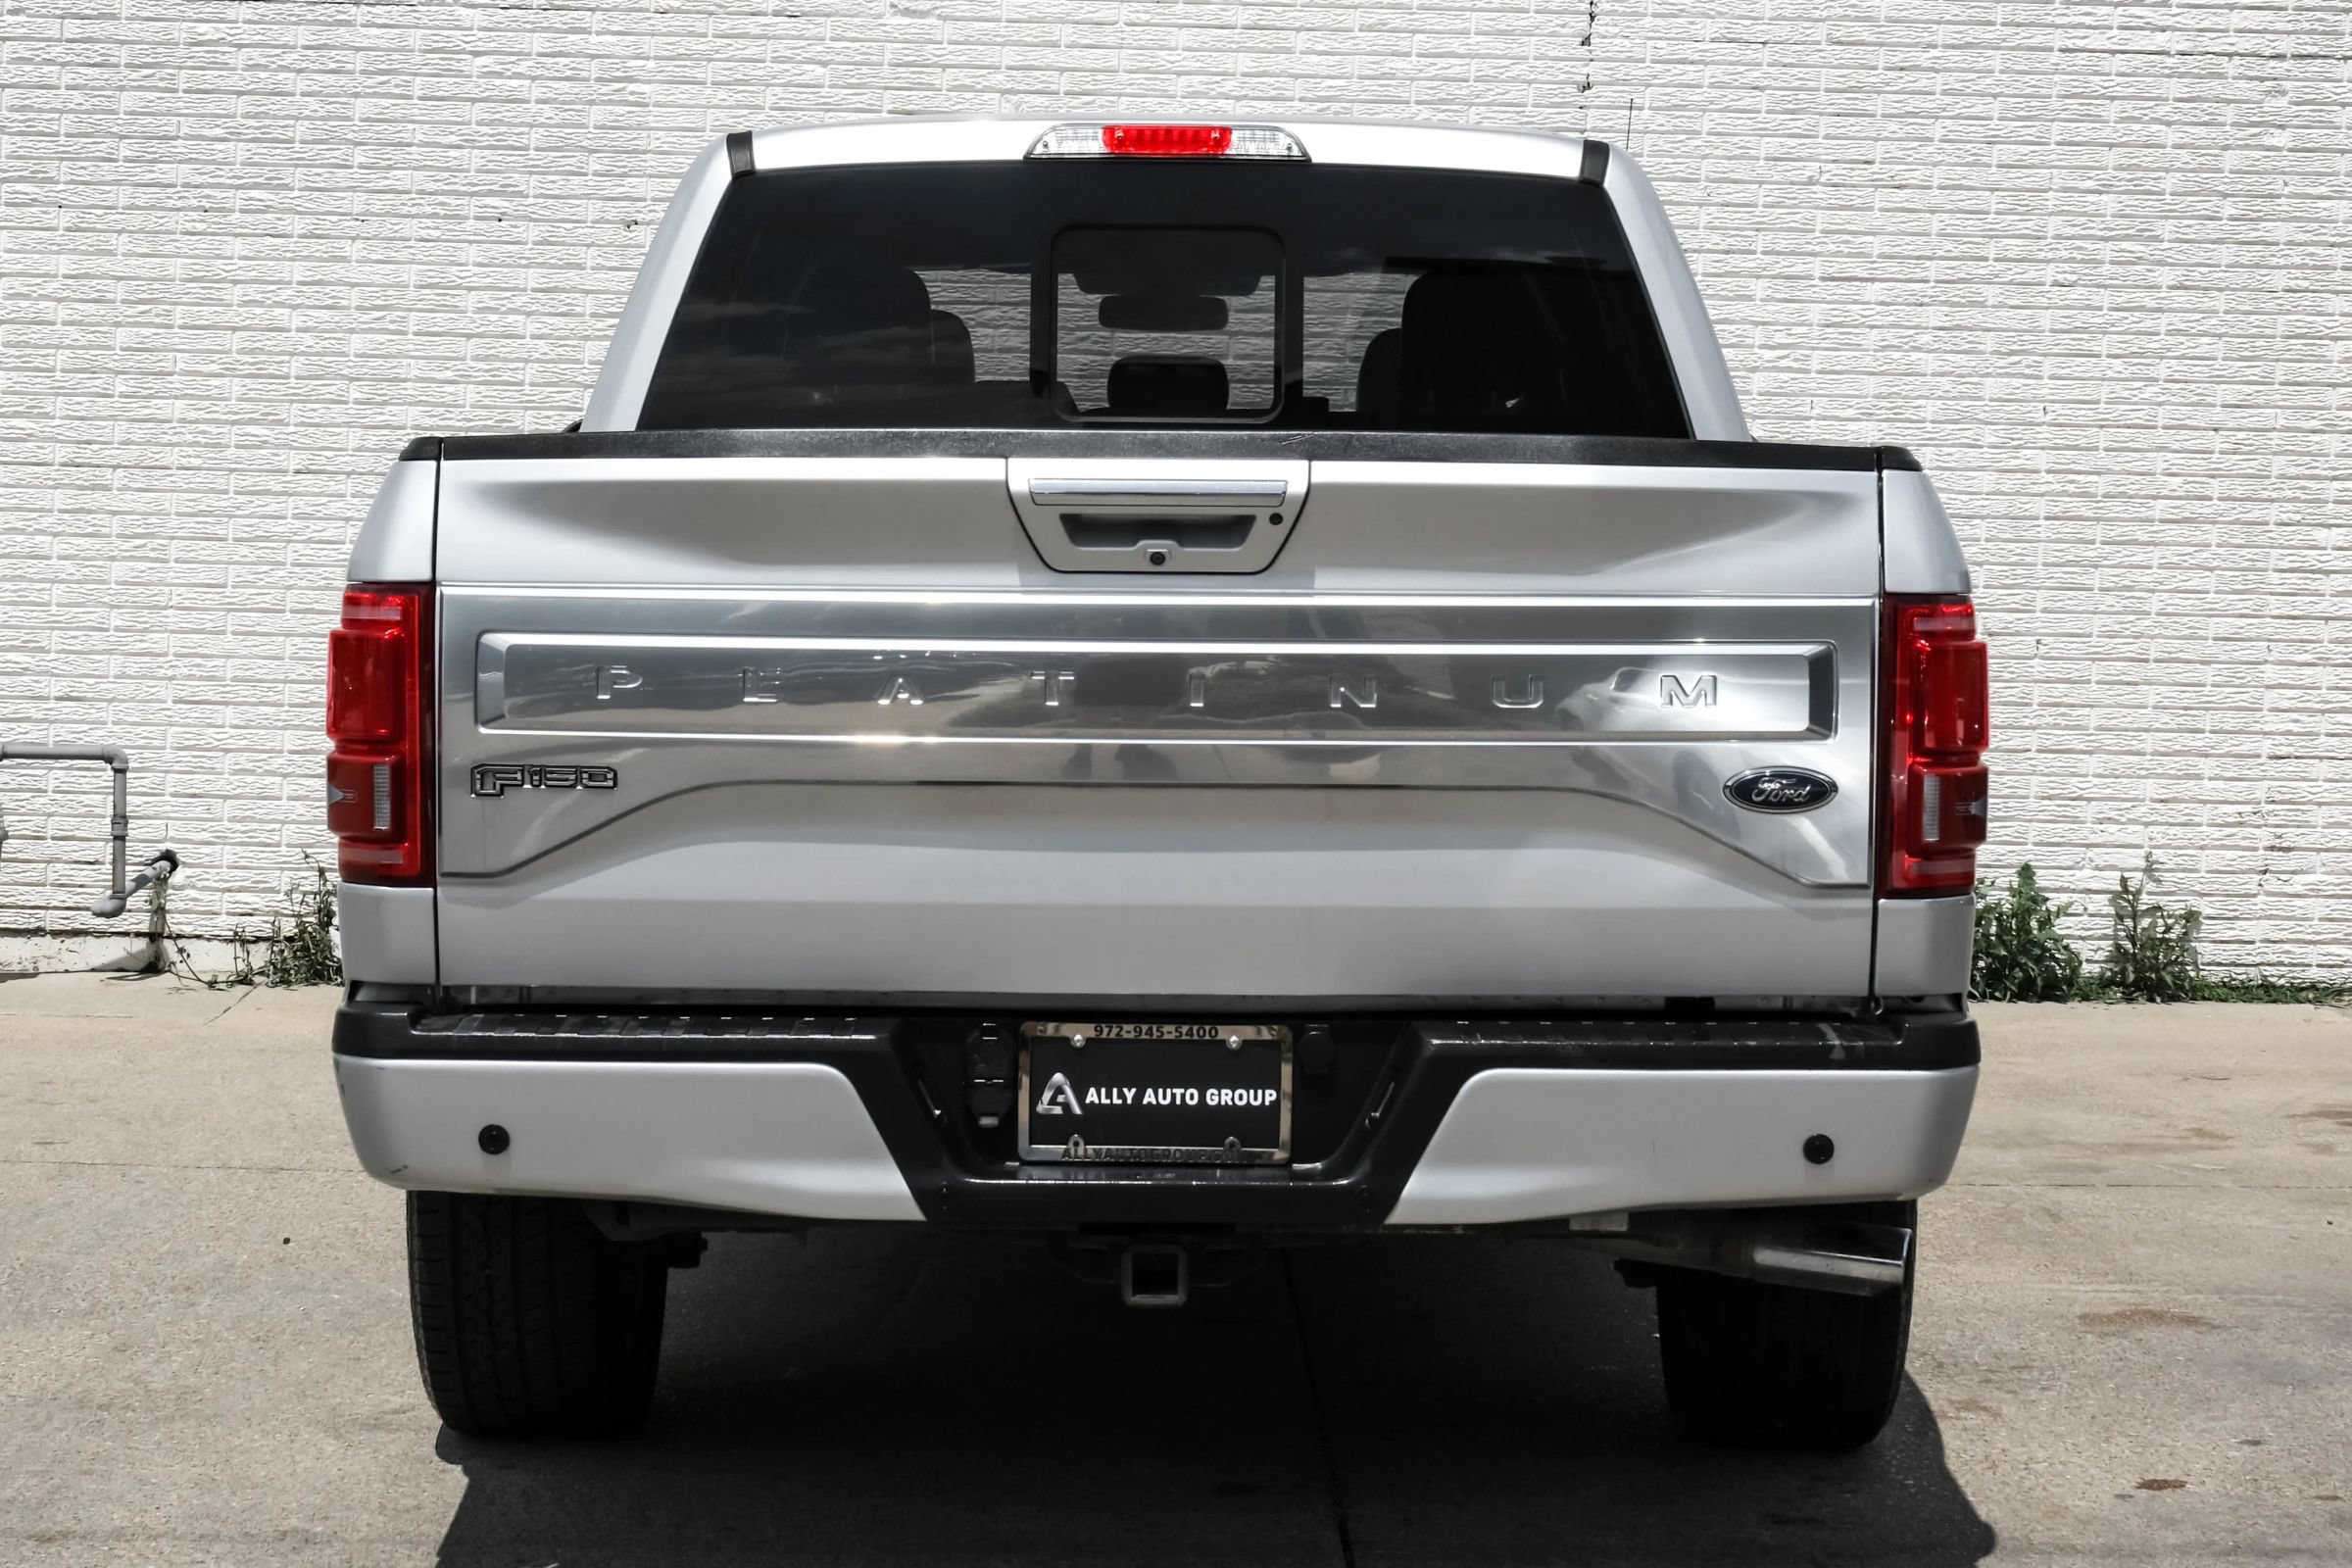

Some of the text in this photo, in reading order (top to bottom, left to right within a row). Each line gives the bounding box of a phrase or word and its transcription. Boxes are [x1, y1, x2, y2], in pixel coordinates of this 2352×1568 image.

[595, 665, 1719, 709] PLATINUM
[1751, 777, 1811, 802] Ford
[1094, 1024, 1219, 1039] 972-945-5400
[1085, 1087, 1277, 1106] ALLY AUTO GROUP
